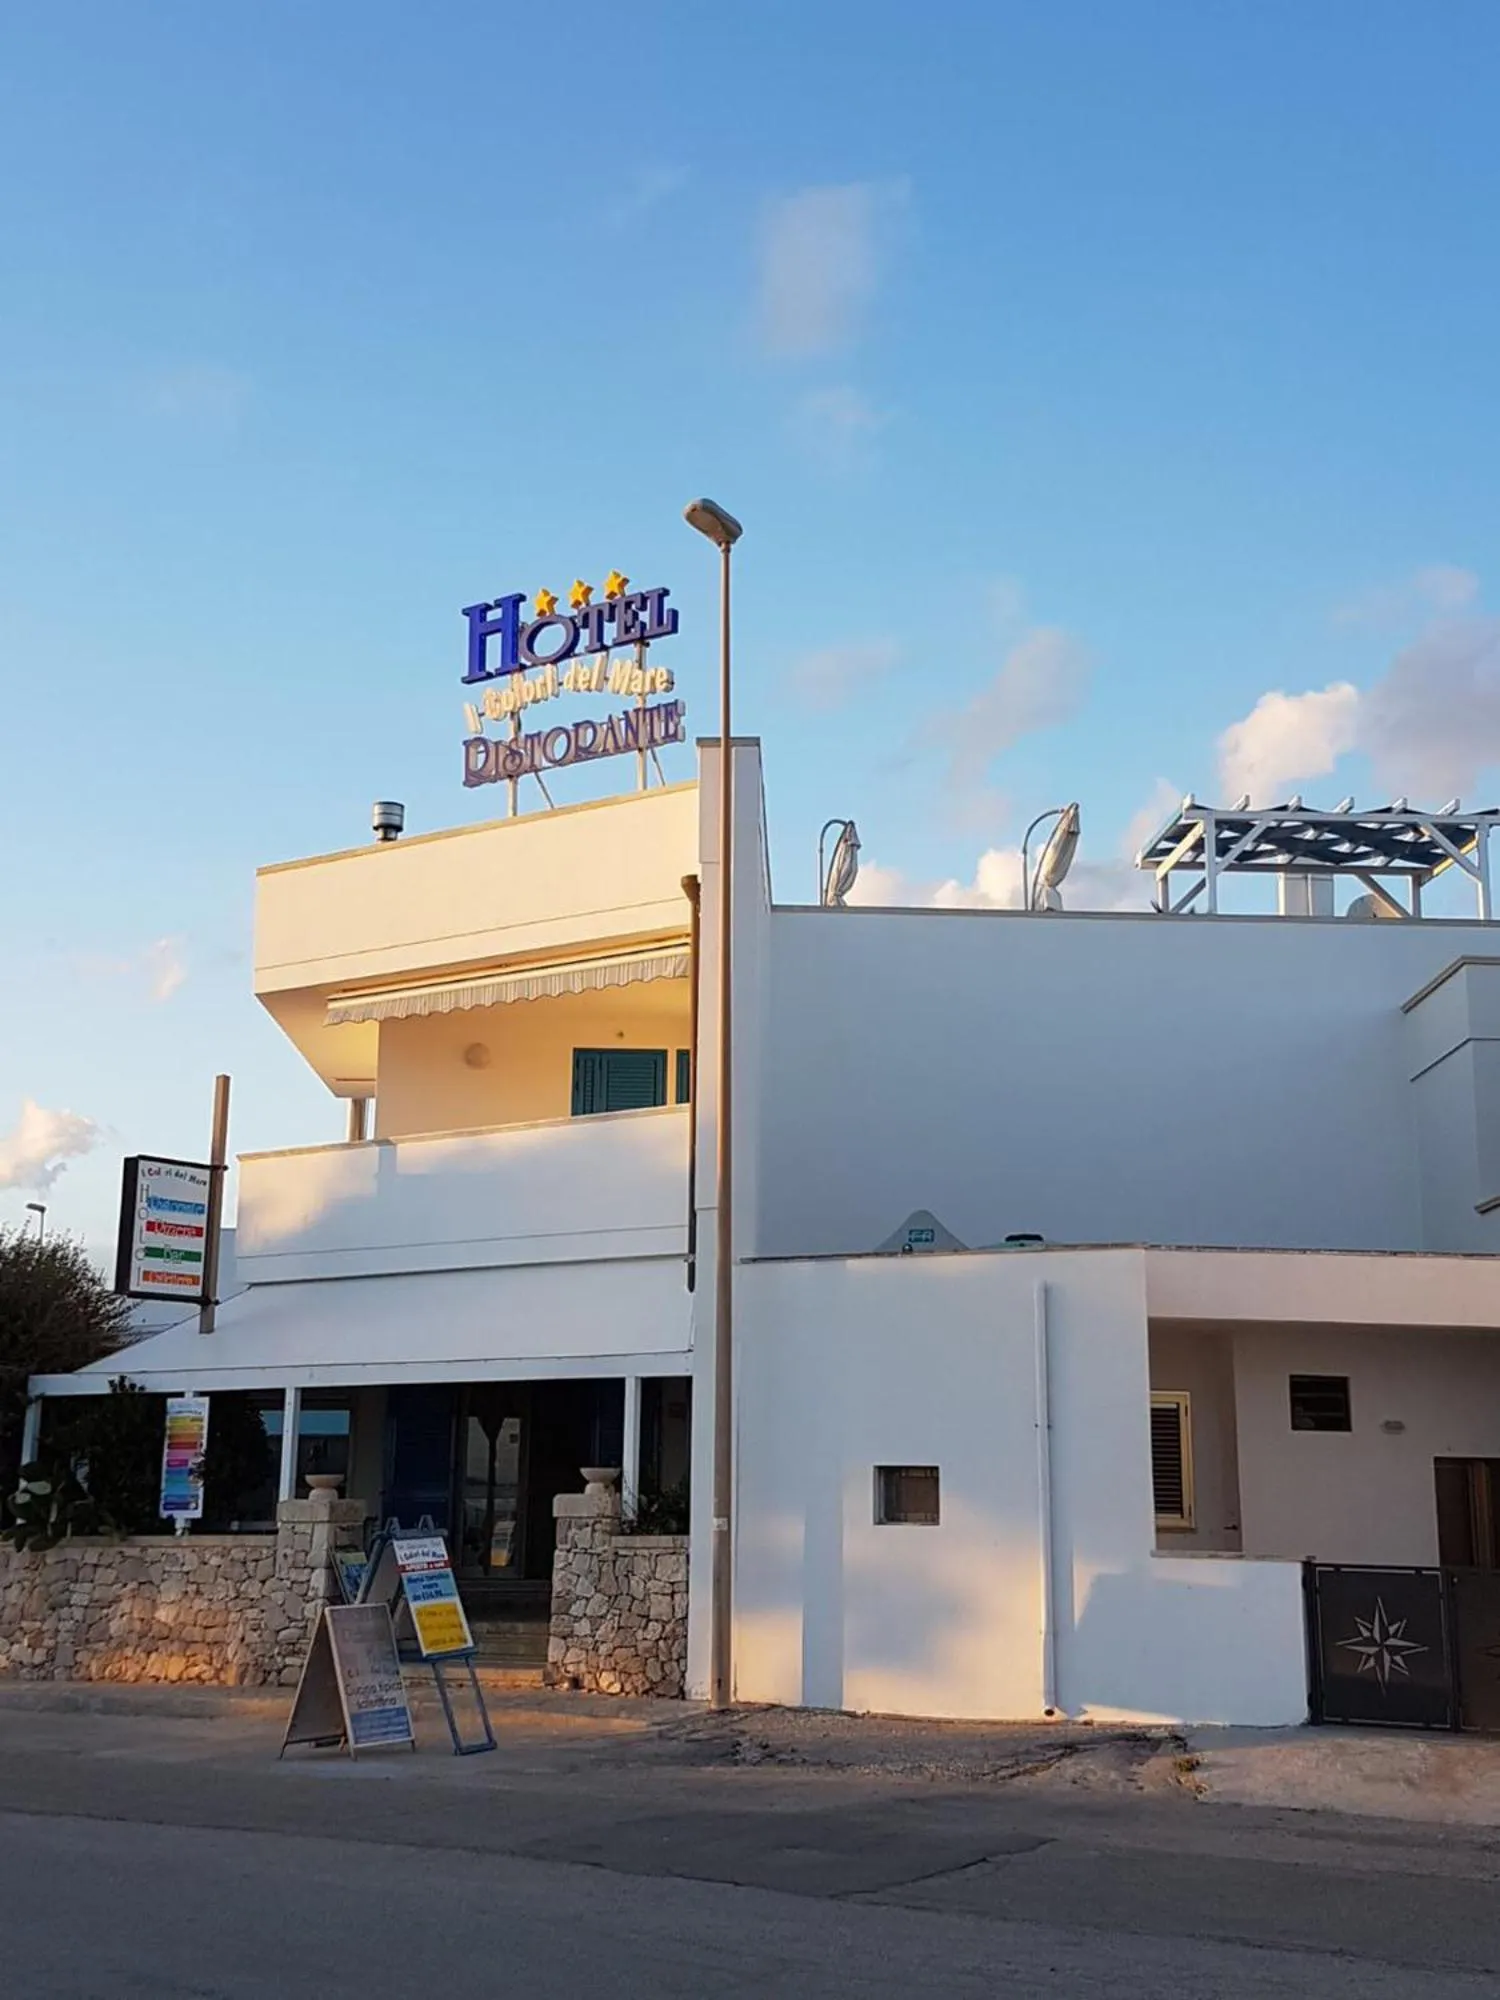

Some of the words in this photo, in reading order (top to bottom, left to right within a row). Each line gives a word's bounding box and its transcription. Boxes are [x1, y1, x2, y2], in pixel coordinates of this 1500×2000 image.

[461, 587, 679, 685] HOTEL
[564, 651, 609, 692] del
[608, 658, 674, 696] Mare
[462, 699, 686, 788] RISTORANTE
[163, 1244, 185, 1265] Bar
